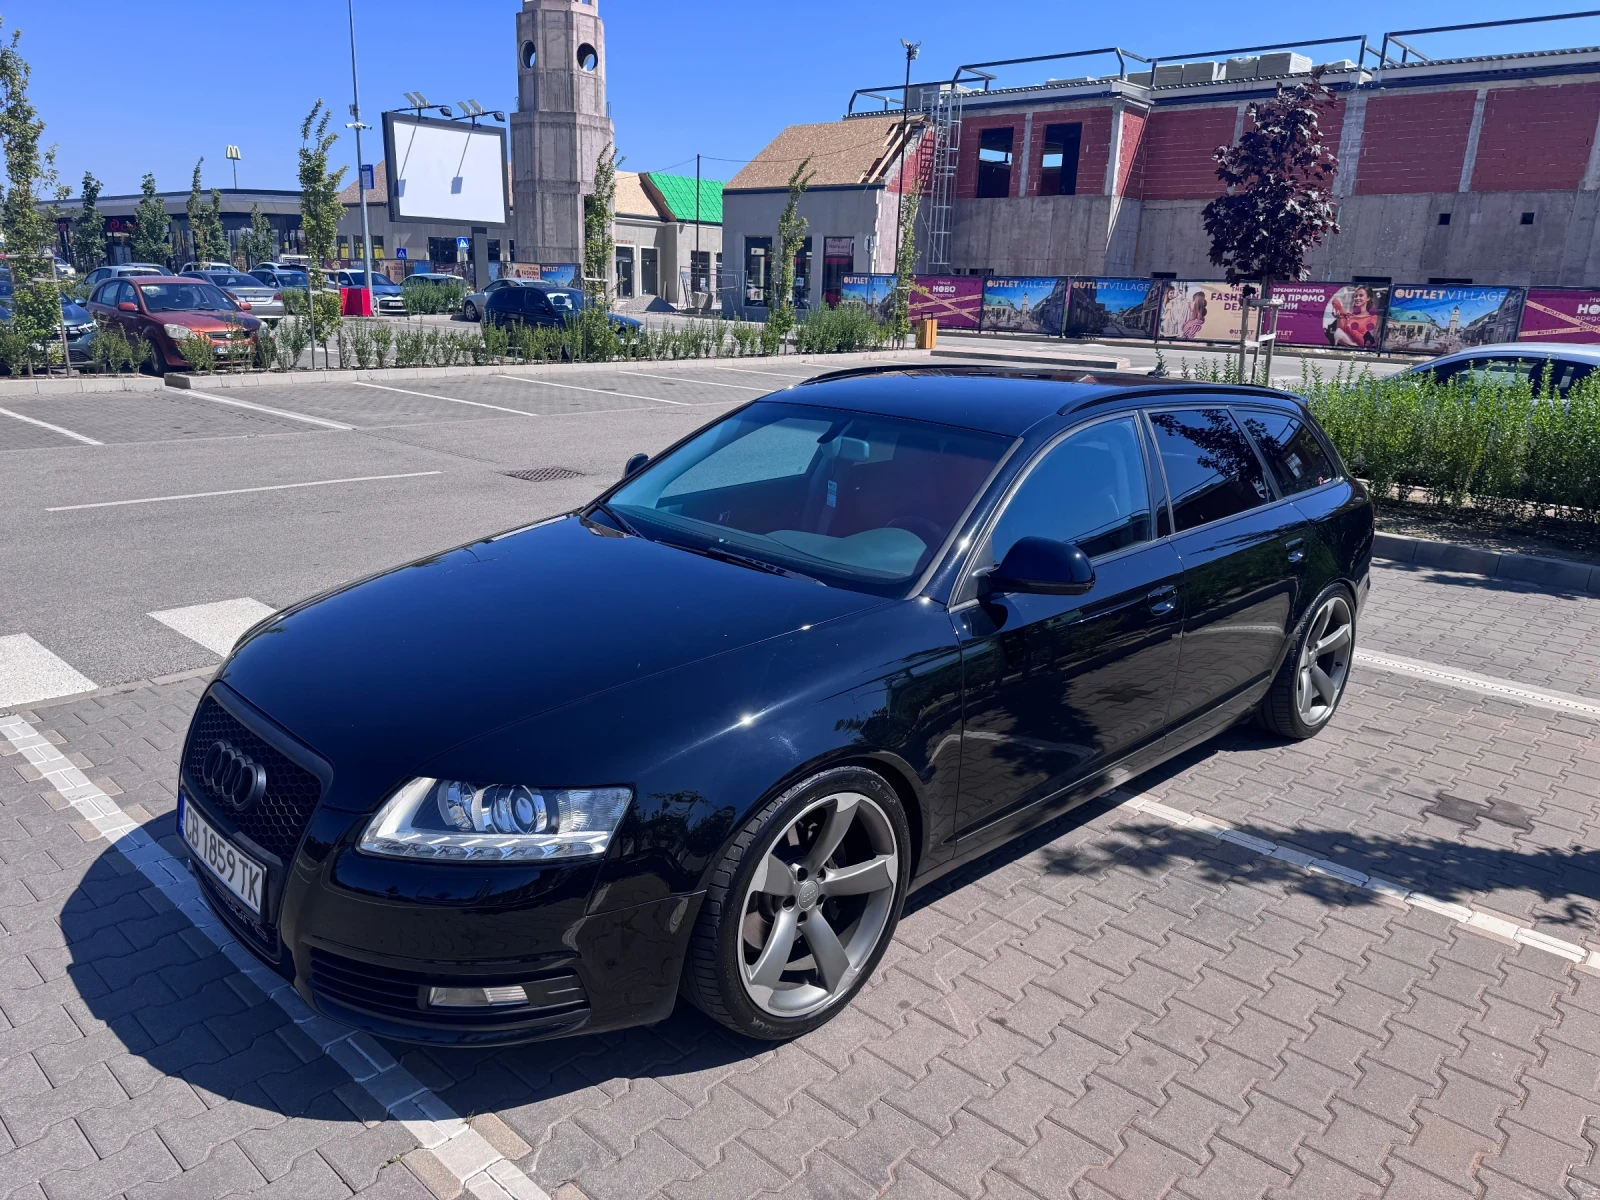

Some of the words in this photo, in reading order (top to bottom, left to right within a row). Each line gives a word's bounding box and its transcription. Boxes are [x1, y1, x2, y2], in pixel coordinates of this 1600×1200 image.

[843, 276, 868, 285] OUTLET
[987, 280, 1020, 288] OUTLET
[1020, 280, 1057, 289] VILLAGE
[932, 285, 956, 293] НОВО
[1073, 281, 1109, 290] OUTLET
[1109, 282, 1151, 292] VILLAGE
[1287, 294, 1326, 302] ПРОМО
[1394, 289, 1447, 299] OUTLET
[1447, 290, 1508, 302] VILLAGE
[1272, 302, 1299, 310] ЕНИ
[185, 806, 199, 849] CB
[202, 826, 236, 883] 1859
[239, 857, 261, 908] TK
